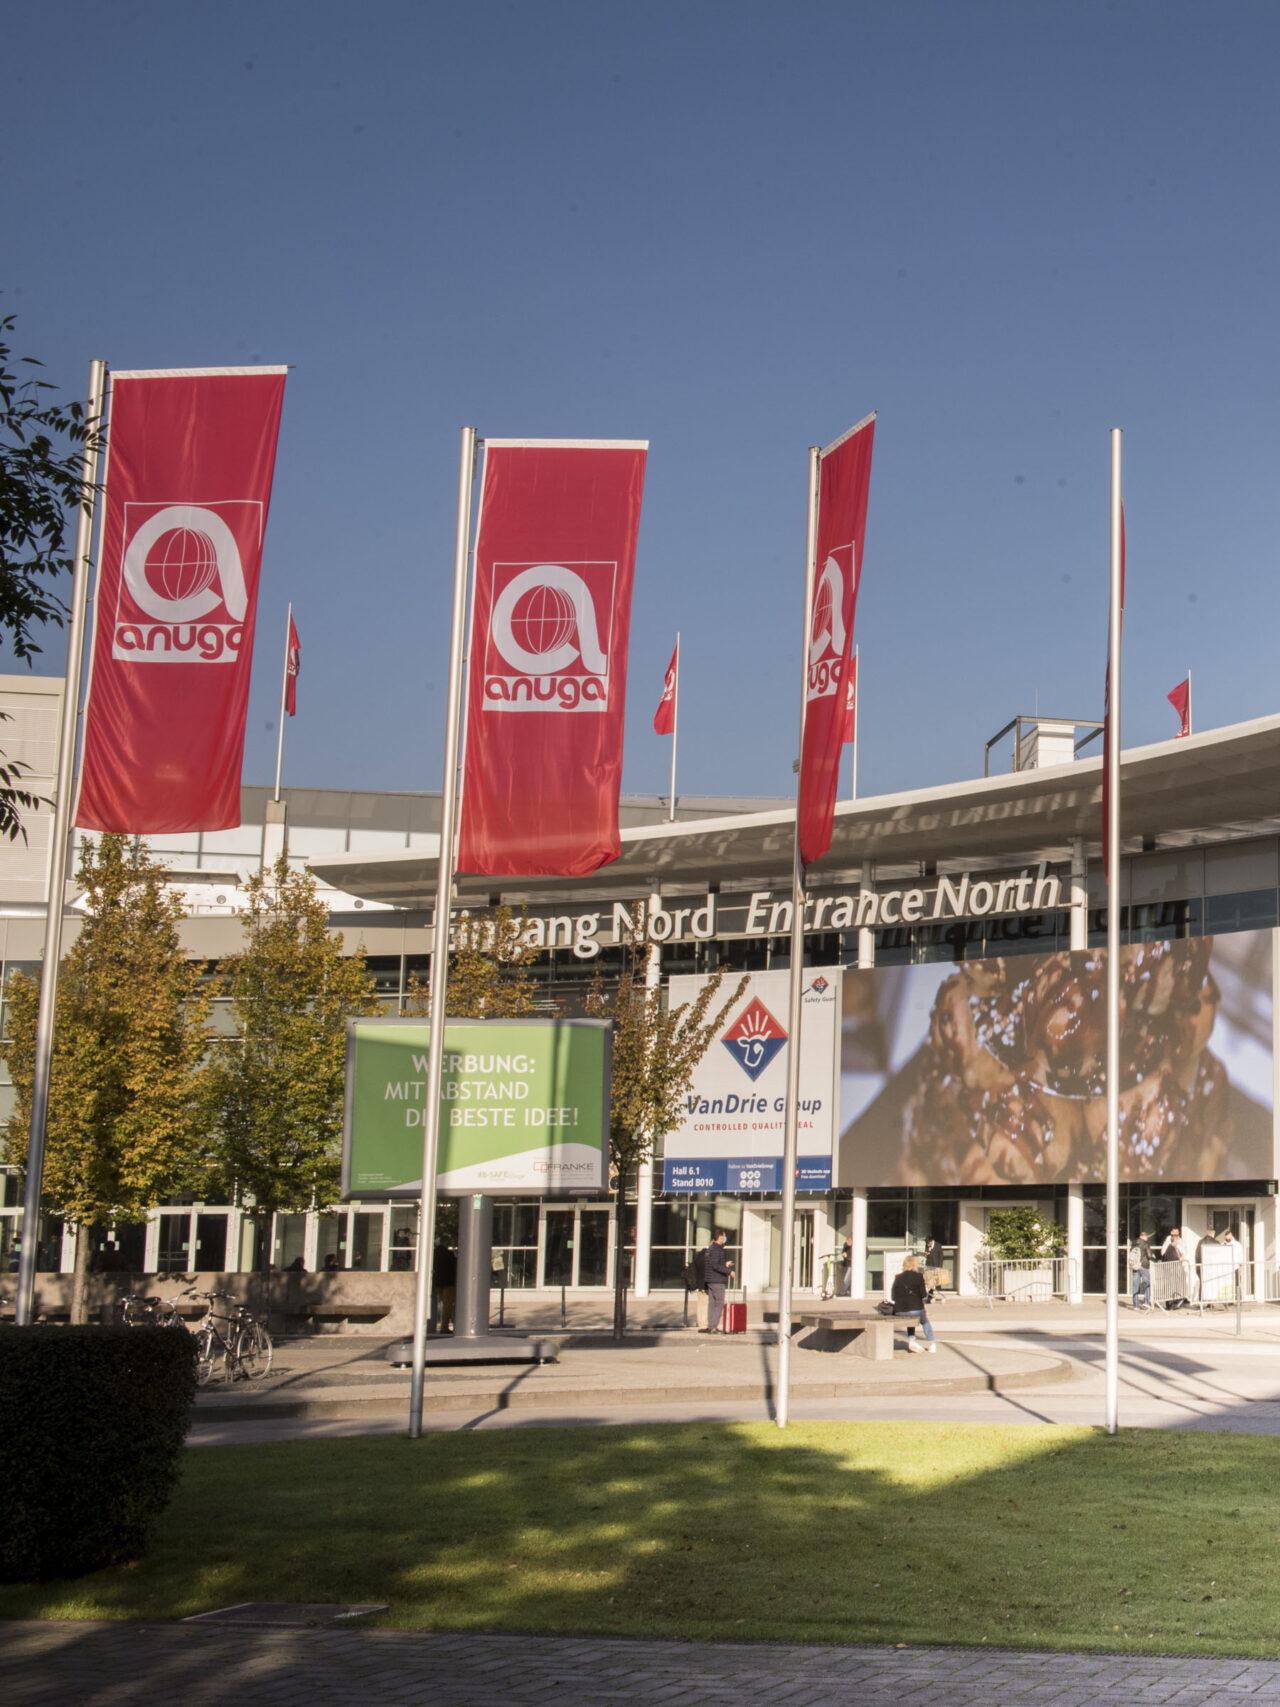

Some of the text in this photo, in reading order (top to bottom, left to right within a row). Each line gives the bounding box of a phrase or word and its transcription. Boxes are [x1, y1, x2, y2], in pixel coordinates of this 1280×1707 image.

[485, 675, 606, 709] anuga
[612, 893, 715, 943] Nord
[933, 872, 1060, 918] North
[385, 1082, 424, 1099] MIT
[687, 1094, 822, 1115] VanDrie Gup
[405, 1108, 579, 1127] DI BESTE IDEE!
[694, 1120, 814, 1131] CONTROLLED QUALIT EAL
[672, 1167, 700, 1175] Hall 6.1
[672, 1178, 714, 1187] Stand B010
